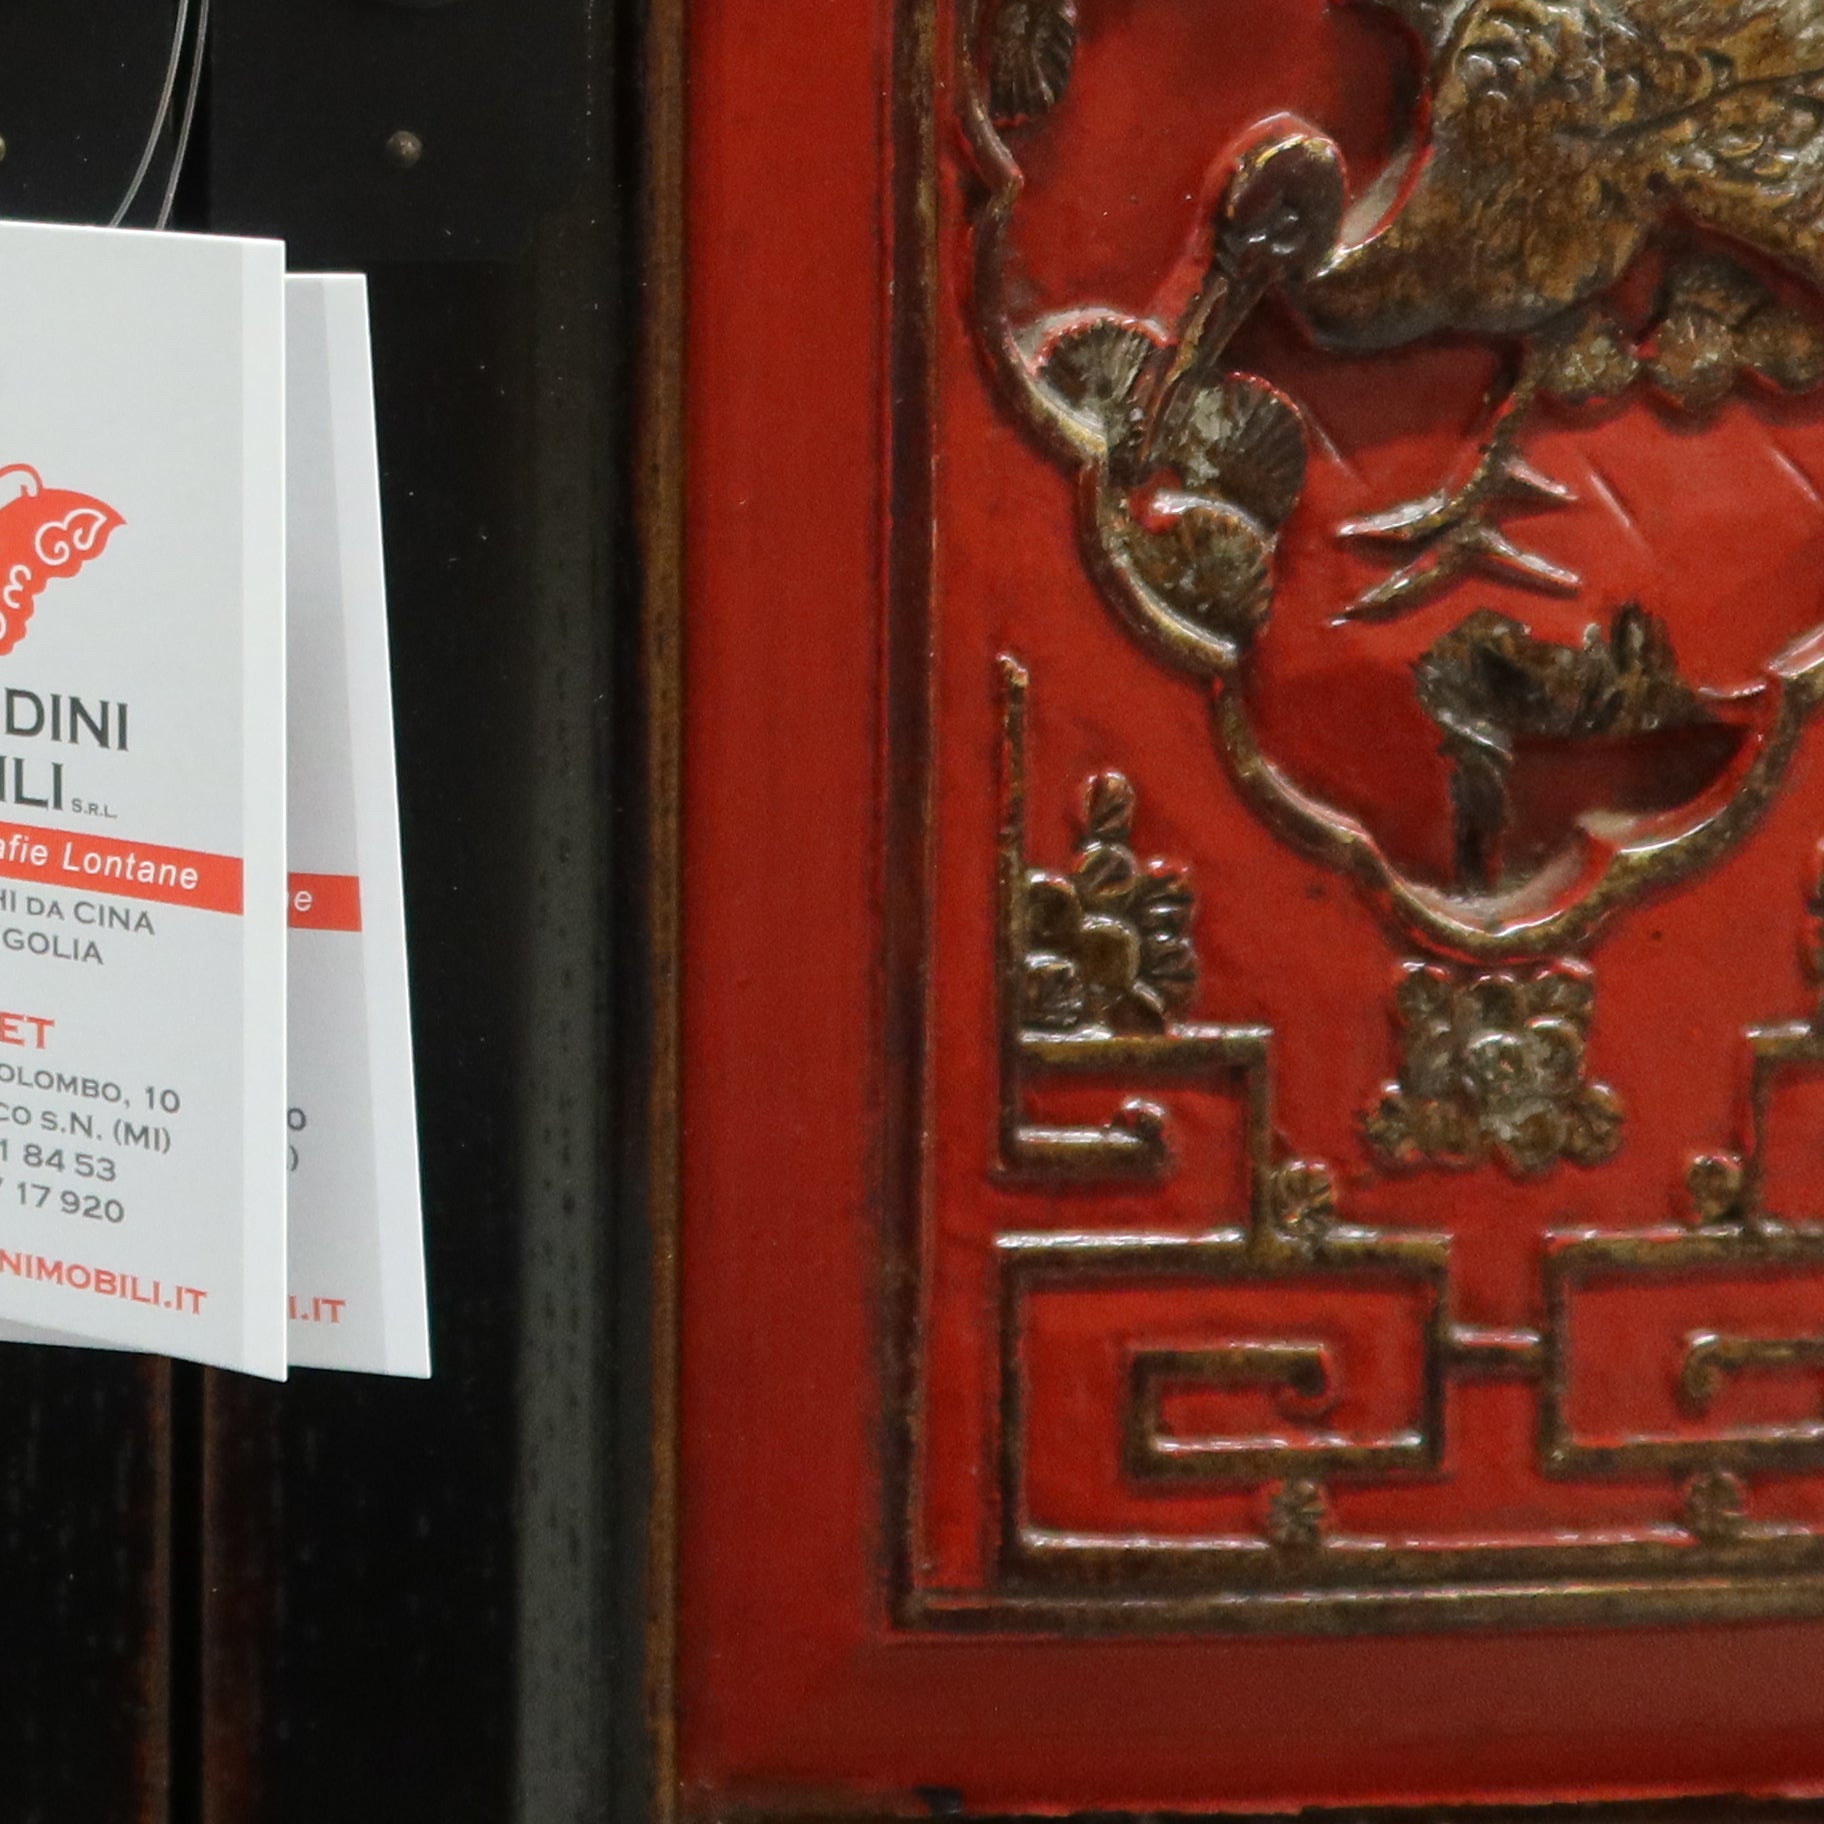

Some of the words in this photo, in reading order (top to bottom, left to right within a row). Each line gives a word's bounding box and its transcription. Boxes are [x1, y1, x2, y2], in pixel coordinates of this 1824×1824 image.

[62, 843, 198, 889] Lontane
[27, 897, 64, 920] DA
[74, 901, 154, 934] CINA
[146, 1087, 180, 1113] 10
[41, 1111, 101, 1140] S.N.
[114, 1119, 170, 1154] (MI)
[23, 1144, 64, 1172] 84
[75, 1153, 116, 1181] 53
[18, 1182, 50, 1207] 17
[61, 1191, 124, 1223] 920
